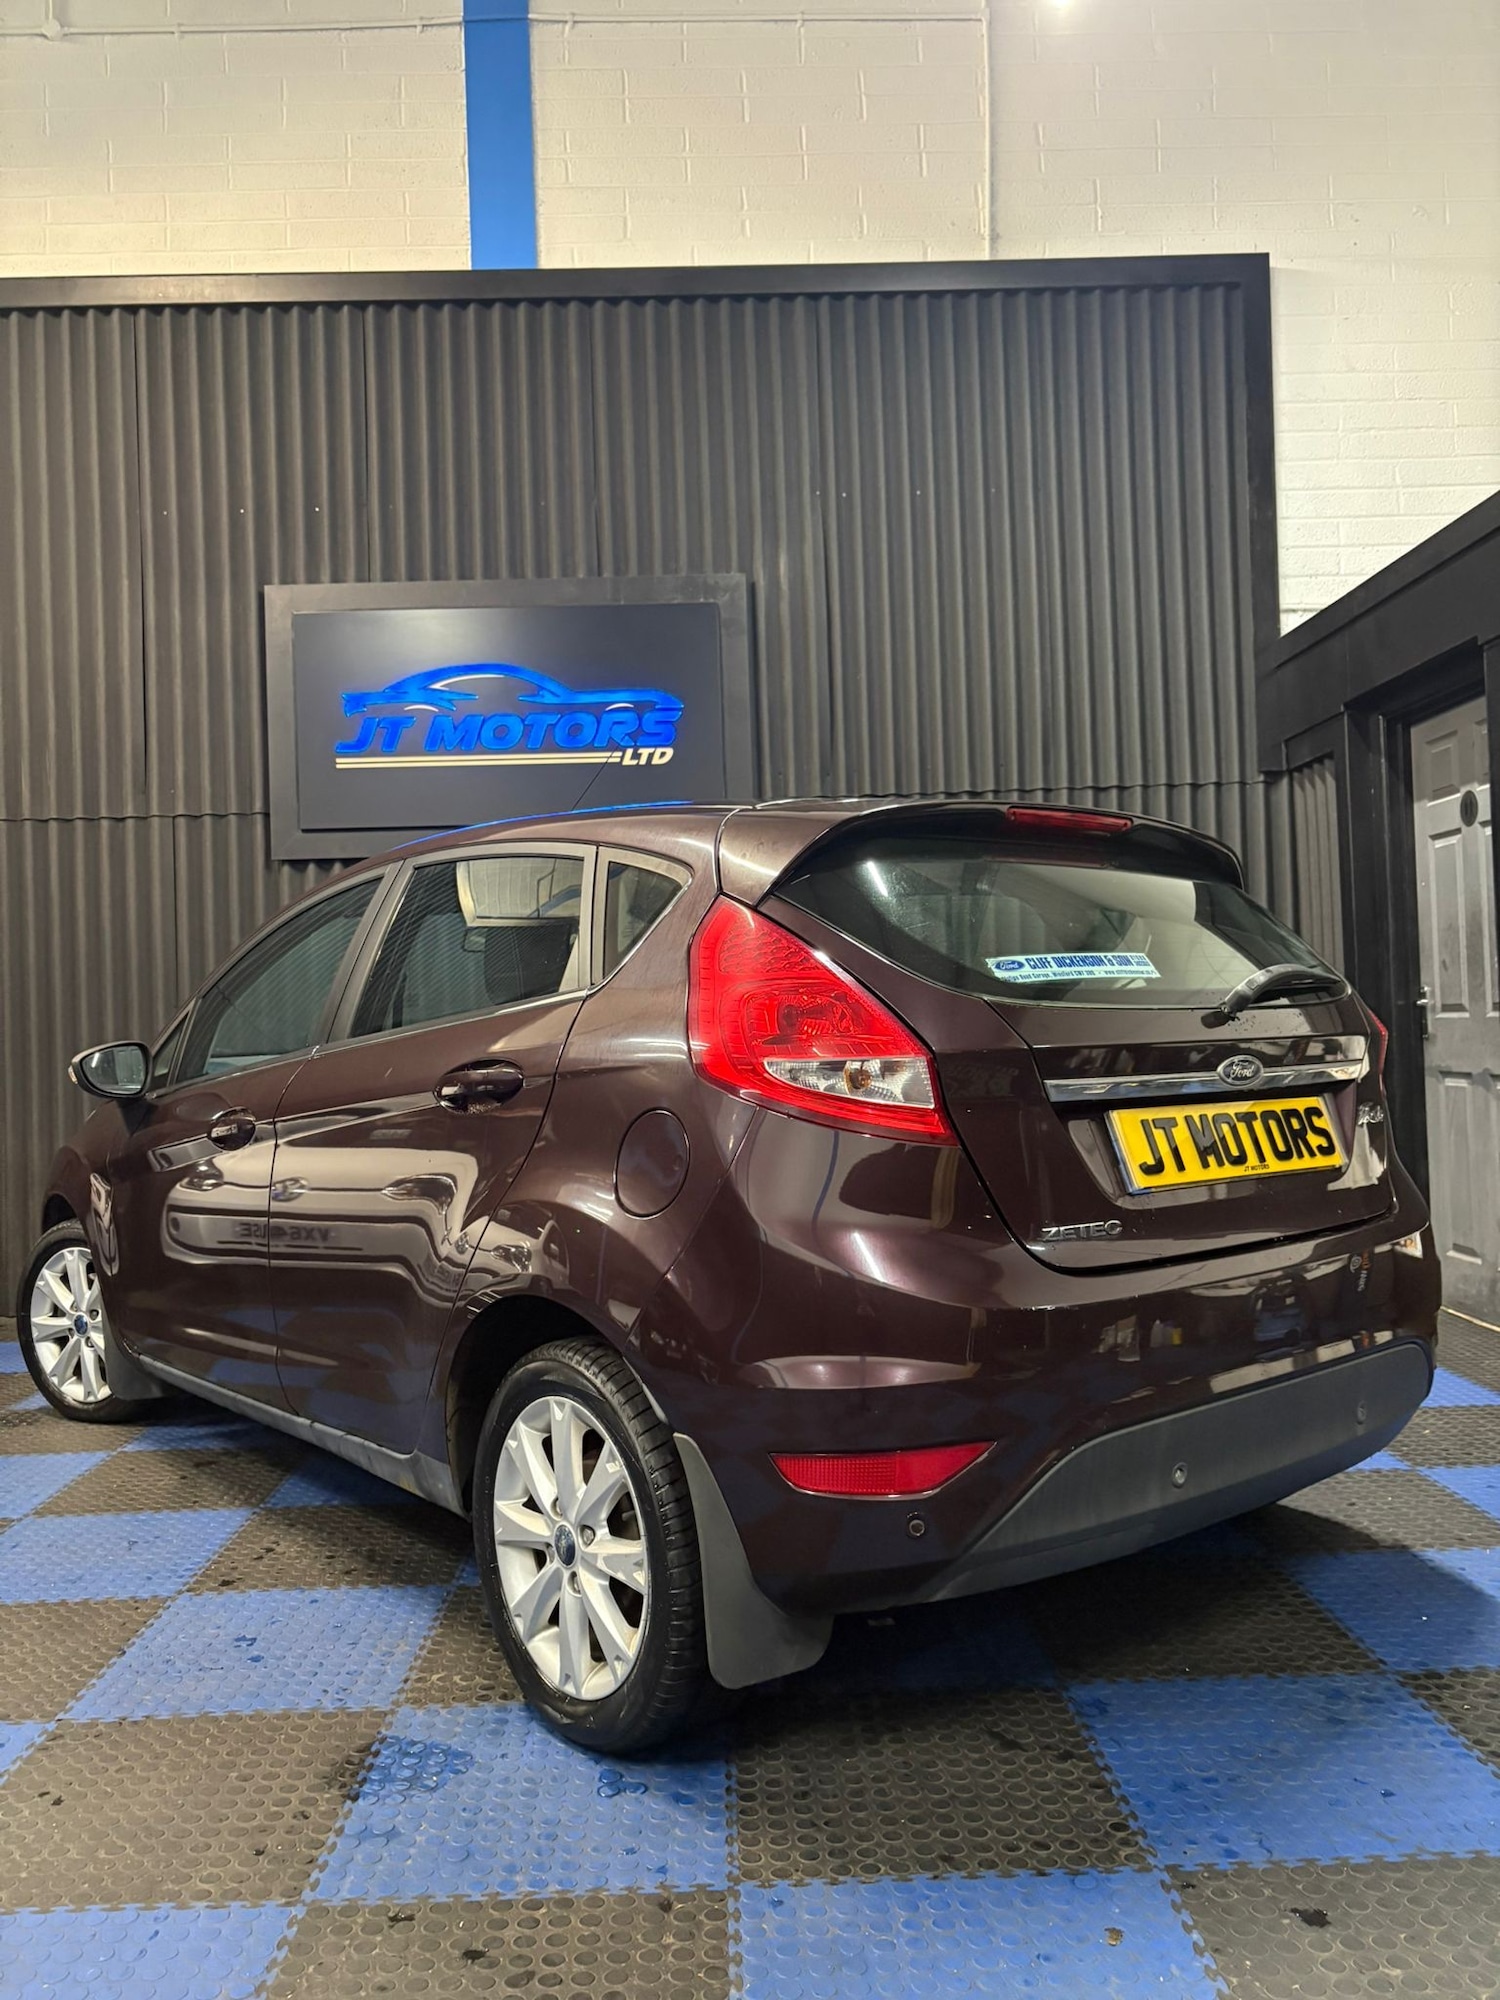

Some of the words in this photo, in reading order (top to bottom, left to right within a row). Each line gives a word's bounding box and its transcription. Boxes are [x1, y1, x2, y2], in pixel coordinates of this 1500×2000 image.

[335, 716, 417, 753] JT
[424, 710, 683, 752] MOTORS
[620, 746, 675, 767] LTD
[1024, 957, 1053, 970] CLIFF
[1050, 955, 1108, 969] DICKENSON
[1103, 955, 1116, 967] &
[1111, 955, 1135, 967] SON
[1231, 1060, 1255, 1078] Ford
[1139, 1116, 1187, 1176] JT
[1184, 1107, 1336, 1169] MOTORS
[1250, 1163, 1270, 1171] MOTORS
[1040, 1219, 1123, 1241] ZETEC
